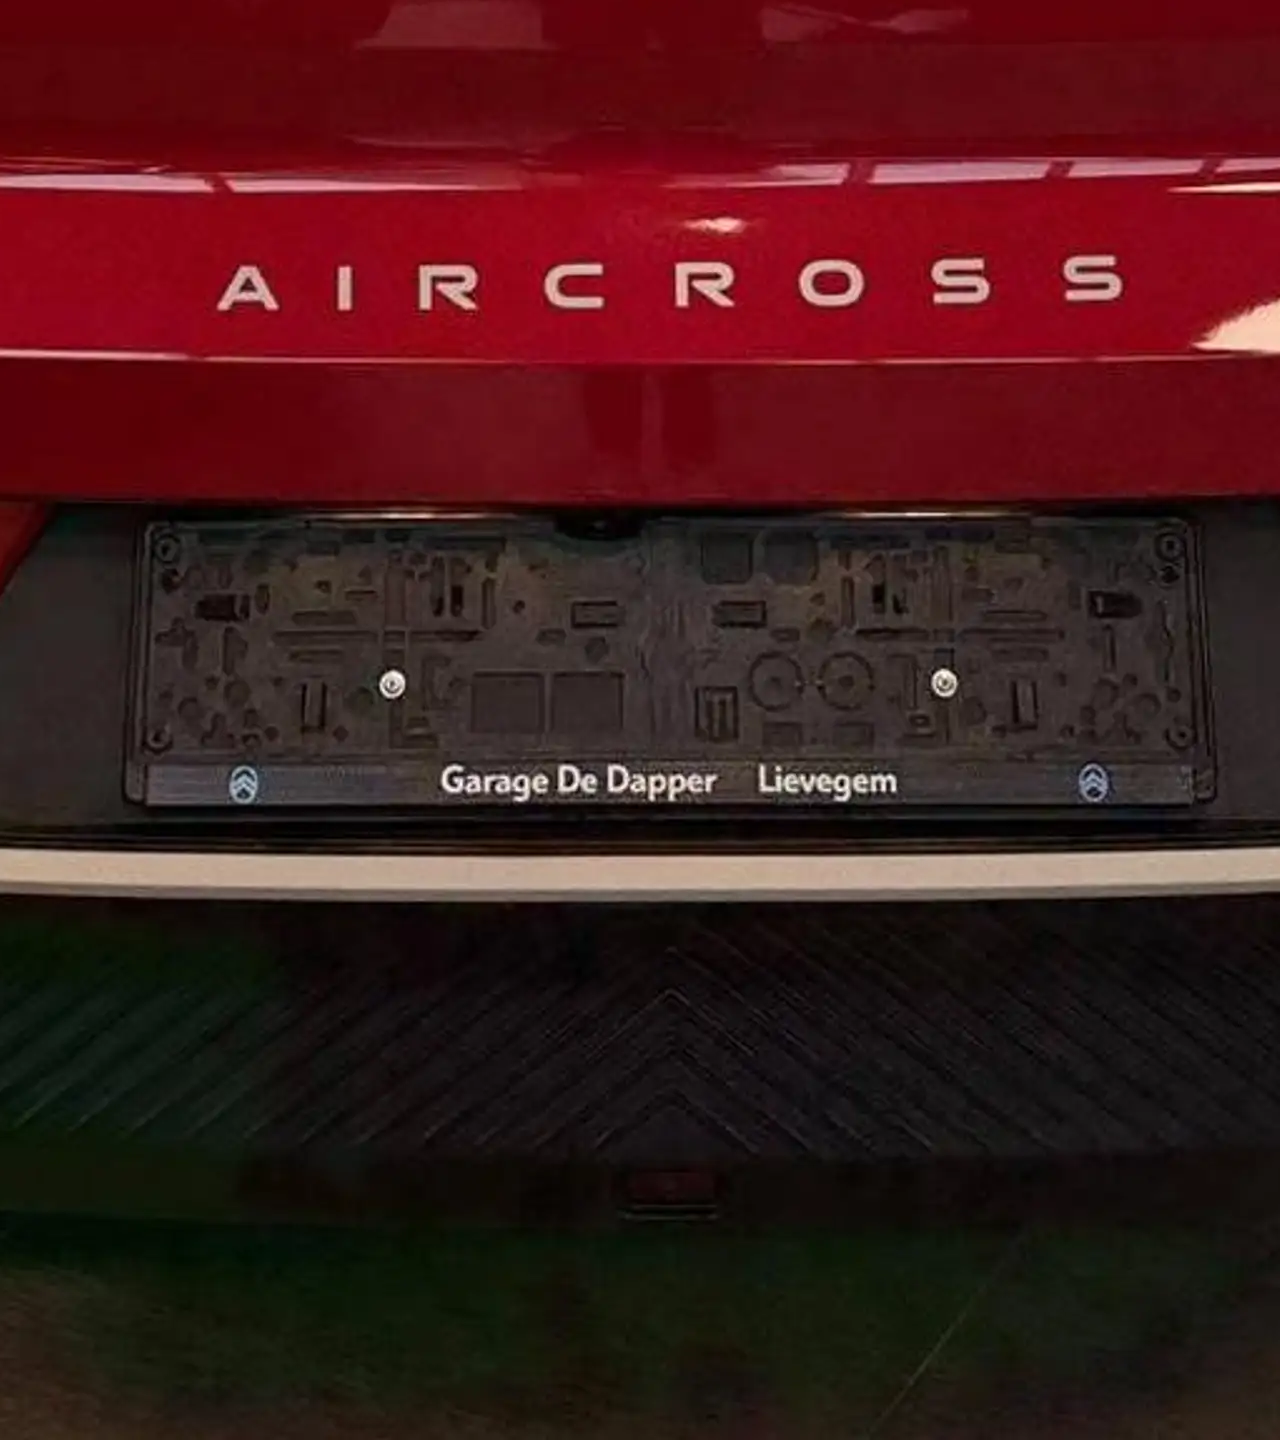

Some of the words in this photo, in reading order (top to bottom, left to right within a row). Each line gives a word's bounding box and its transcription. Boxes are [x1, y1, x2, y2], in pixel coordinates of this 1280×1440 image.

[217, 254, 1125, 312] AIRCROSS
[440, 764, 549, 802] Garage
[557, 765, 598, 794] De
[606, 764, 718, 802] Dapper
[758, 764, 898, 802] Lievegem
